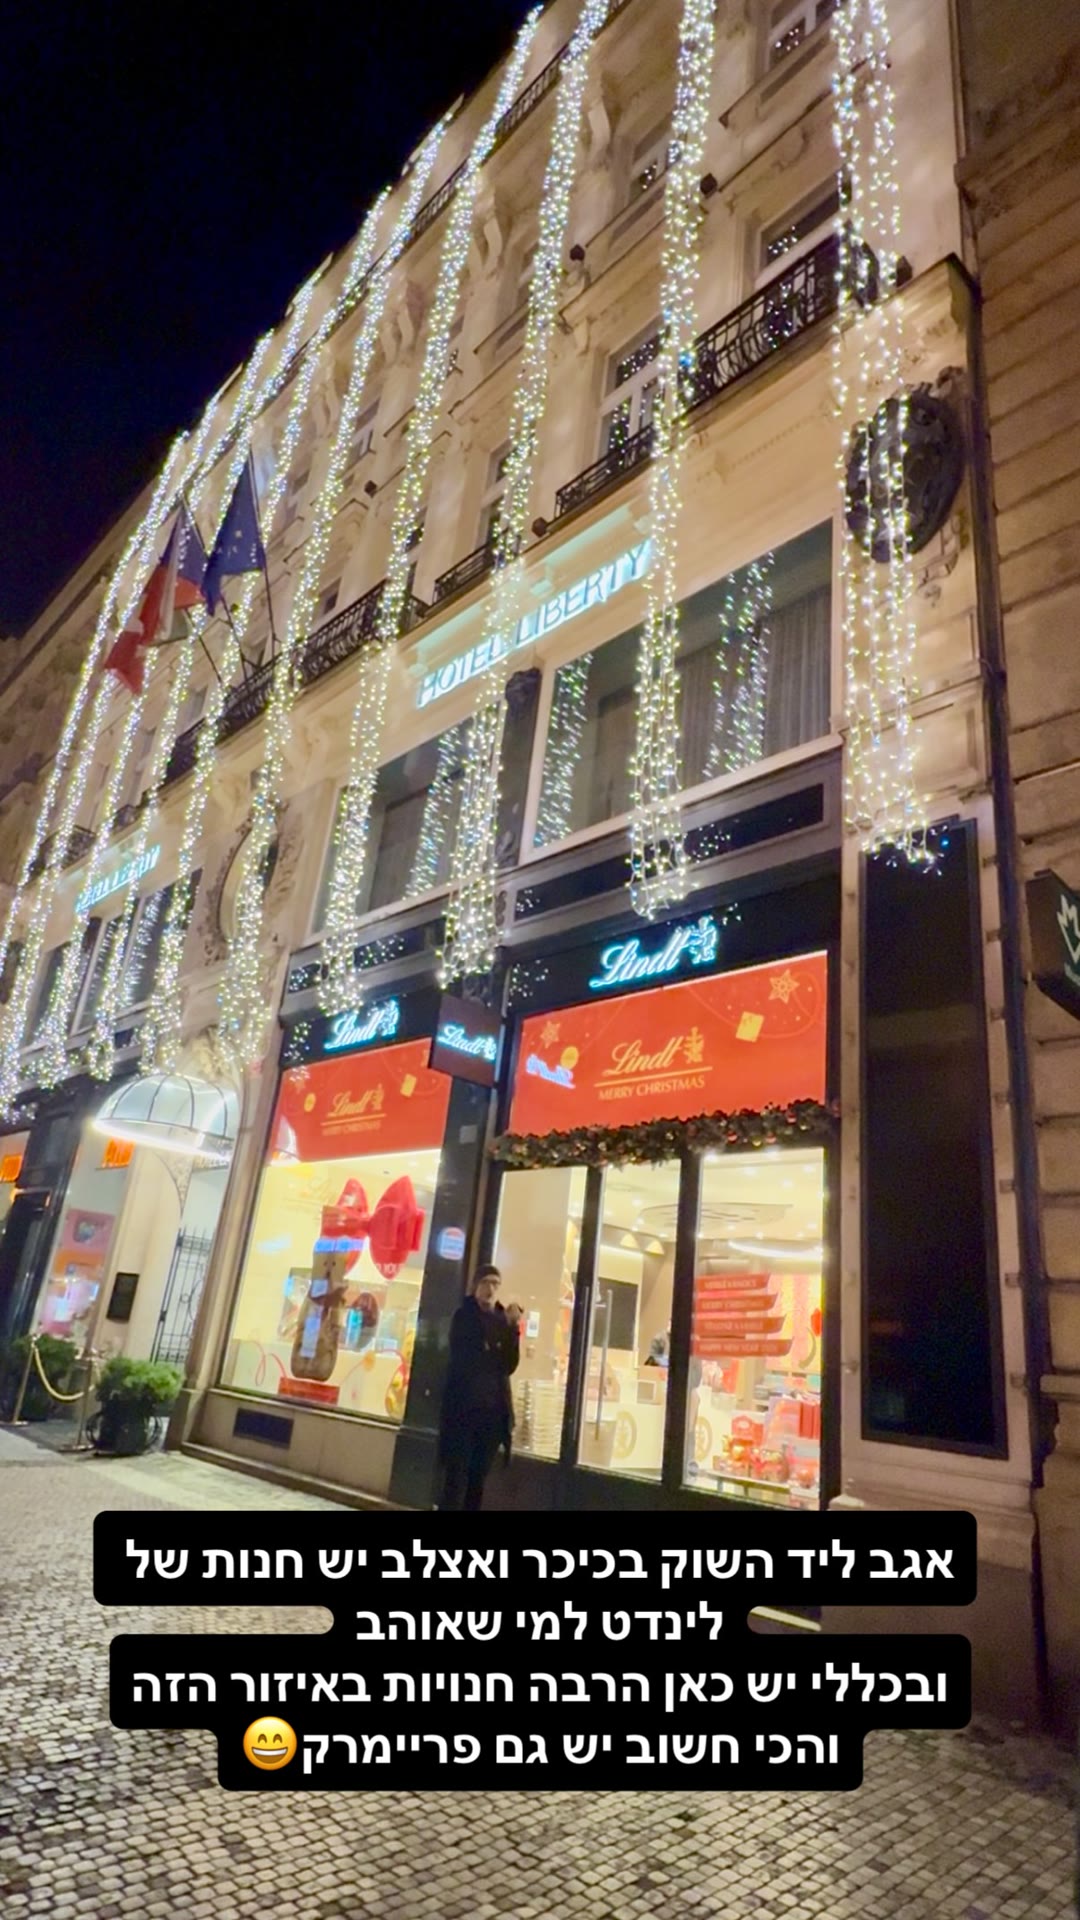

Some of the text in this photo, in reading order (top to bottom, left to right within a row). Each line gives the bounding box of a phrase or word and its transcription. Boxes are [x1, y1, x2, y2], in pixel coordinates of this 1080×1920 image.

[416, 538, 651, 708] HOTEL LIBERTY
[588, 927, 691, 988] Lindt
[324, 1009, 385, 1050] Lindt
[437, 1025, 486, 1055] Lindt
[602, 1035, 684, 1074] Lindt
[599, 1074, 705, 1100] MERRY CHRISTMAS
